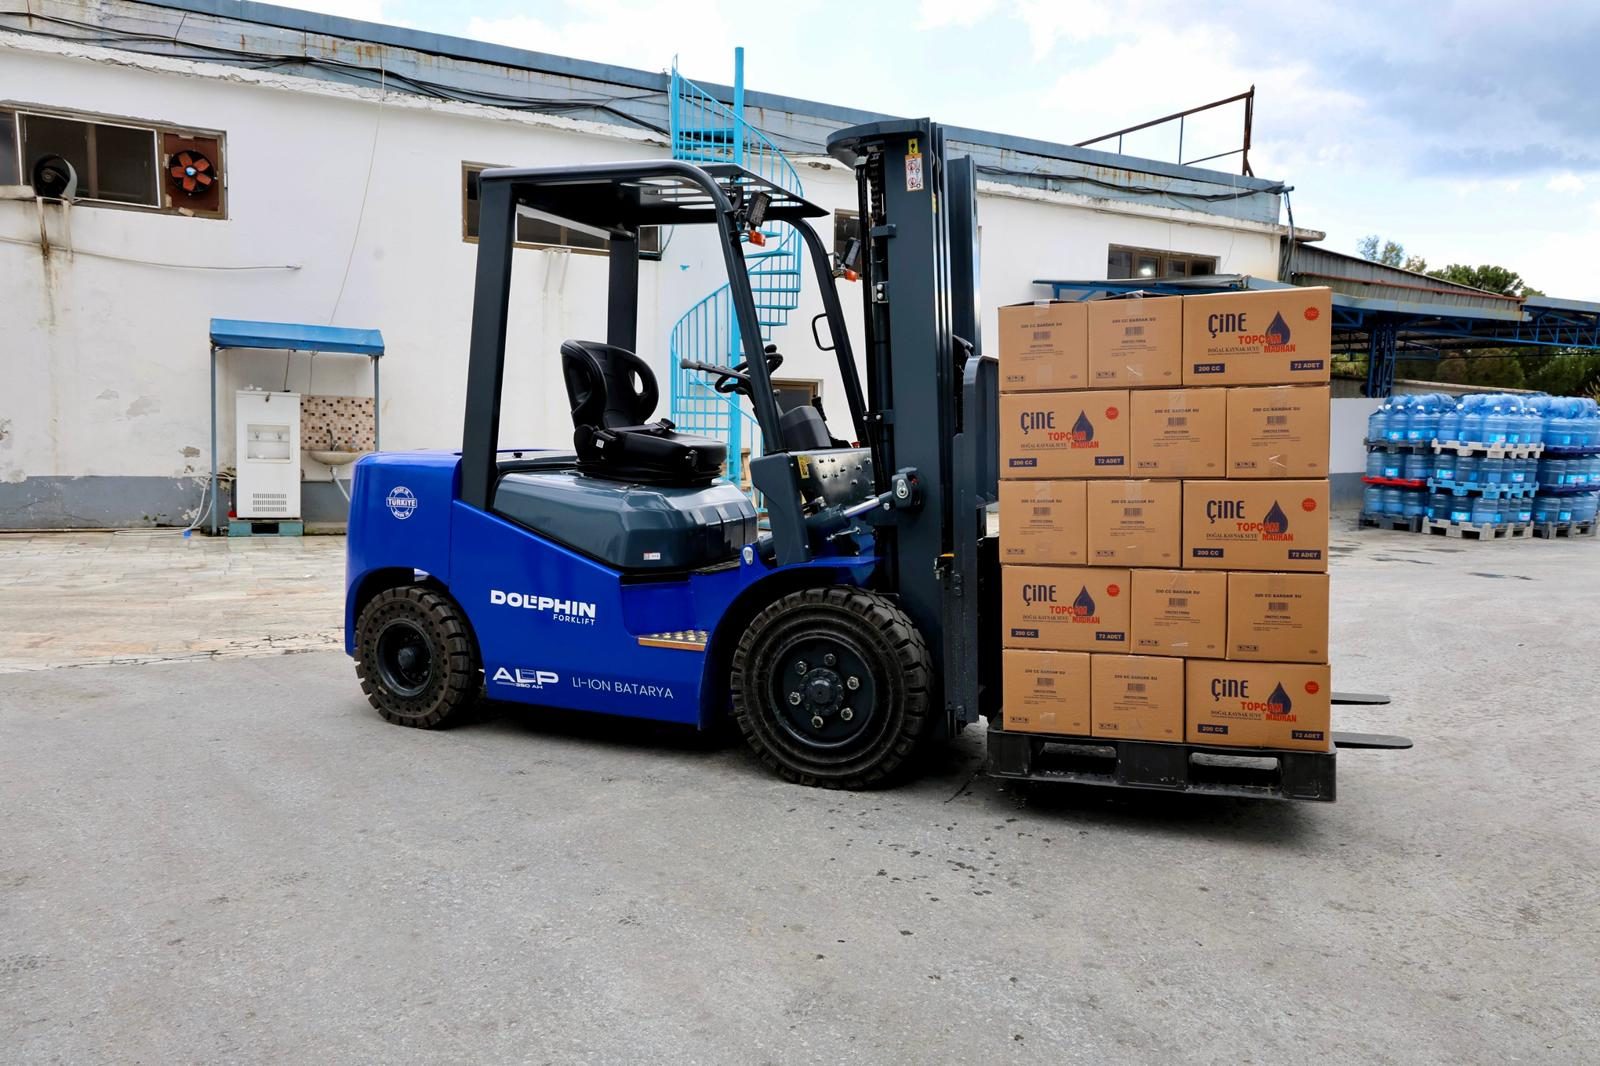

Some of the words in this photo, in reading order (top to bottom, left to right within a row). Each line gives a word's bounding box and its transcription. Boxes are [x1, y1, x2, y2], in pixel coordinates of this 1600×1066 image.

[491, 590, 596, 618] DOLPHIN
[553, 614, 595, 625] FORKLIFT
[492, 667, 559, 685] ALP
[573, 677, 611, 691] LI-ION
[615, 682, 673, 699] BATARYA
